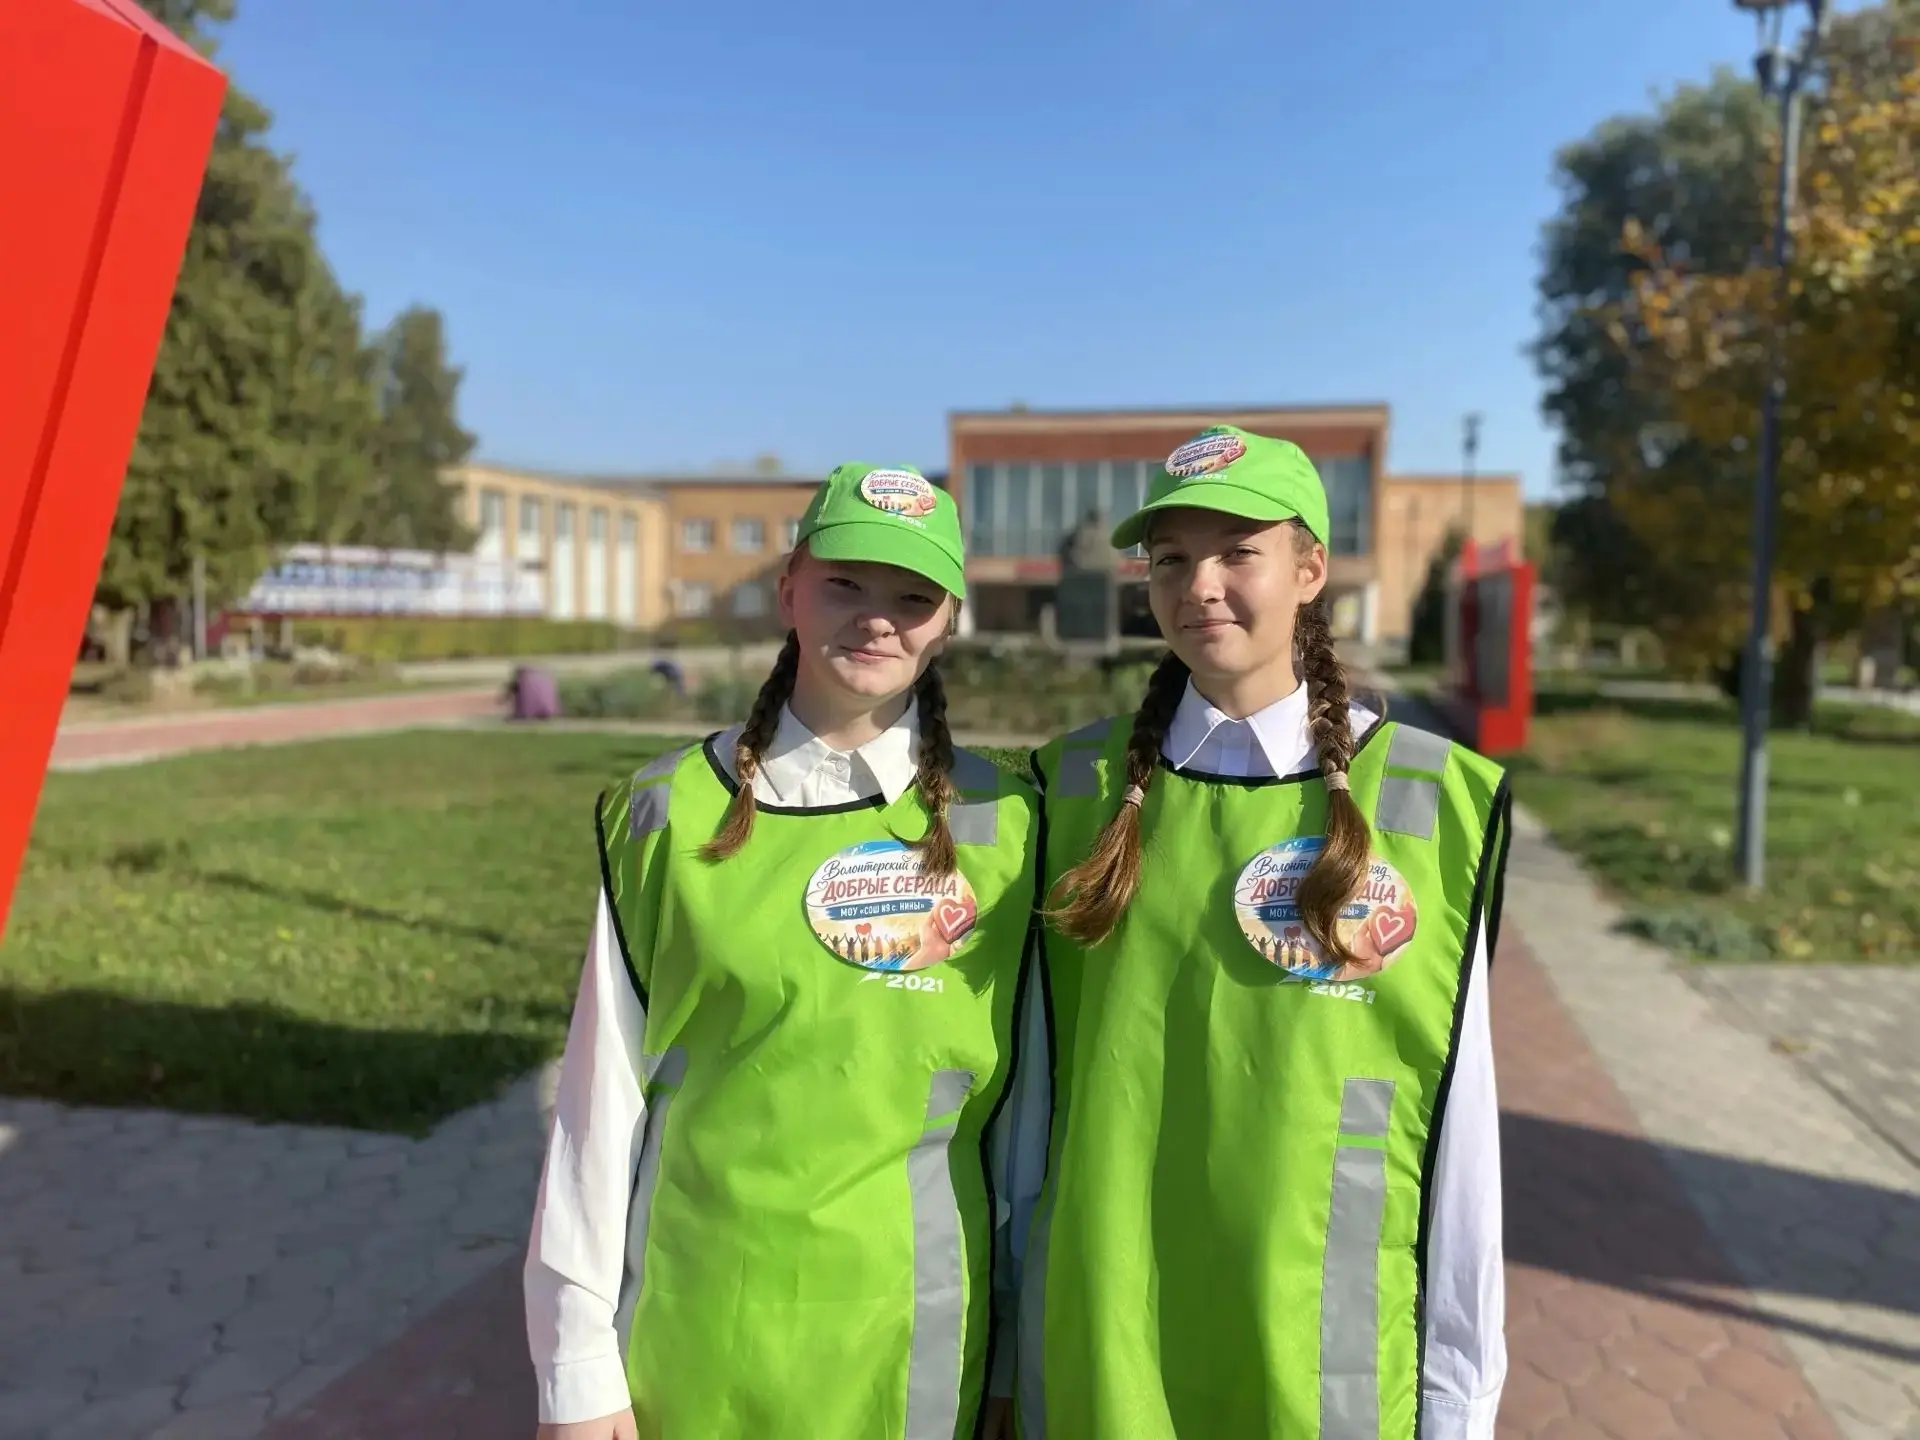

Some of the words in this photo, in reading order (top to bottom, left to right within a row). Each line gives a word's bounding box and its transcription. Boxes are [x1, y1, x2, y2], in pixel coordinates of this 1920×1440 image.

[868, 479, 899, 488] ДОБРЫЕ
[822, 858, 909, 880] Волонтерский
[821, 877, 890, 903] ДОБРЫЕ
[893, 875, 957, 897] СЕРДЦА
[1250, 877, 1302, 902] ДОБР
[840, 907, 858, 917] МОУ
[1269, 907, 1288, 918] МОУ
[886, 974, 944, 993] 2021
[1308, 980, 1376, 1005] 2021
